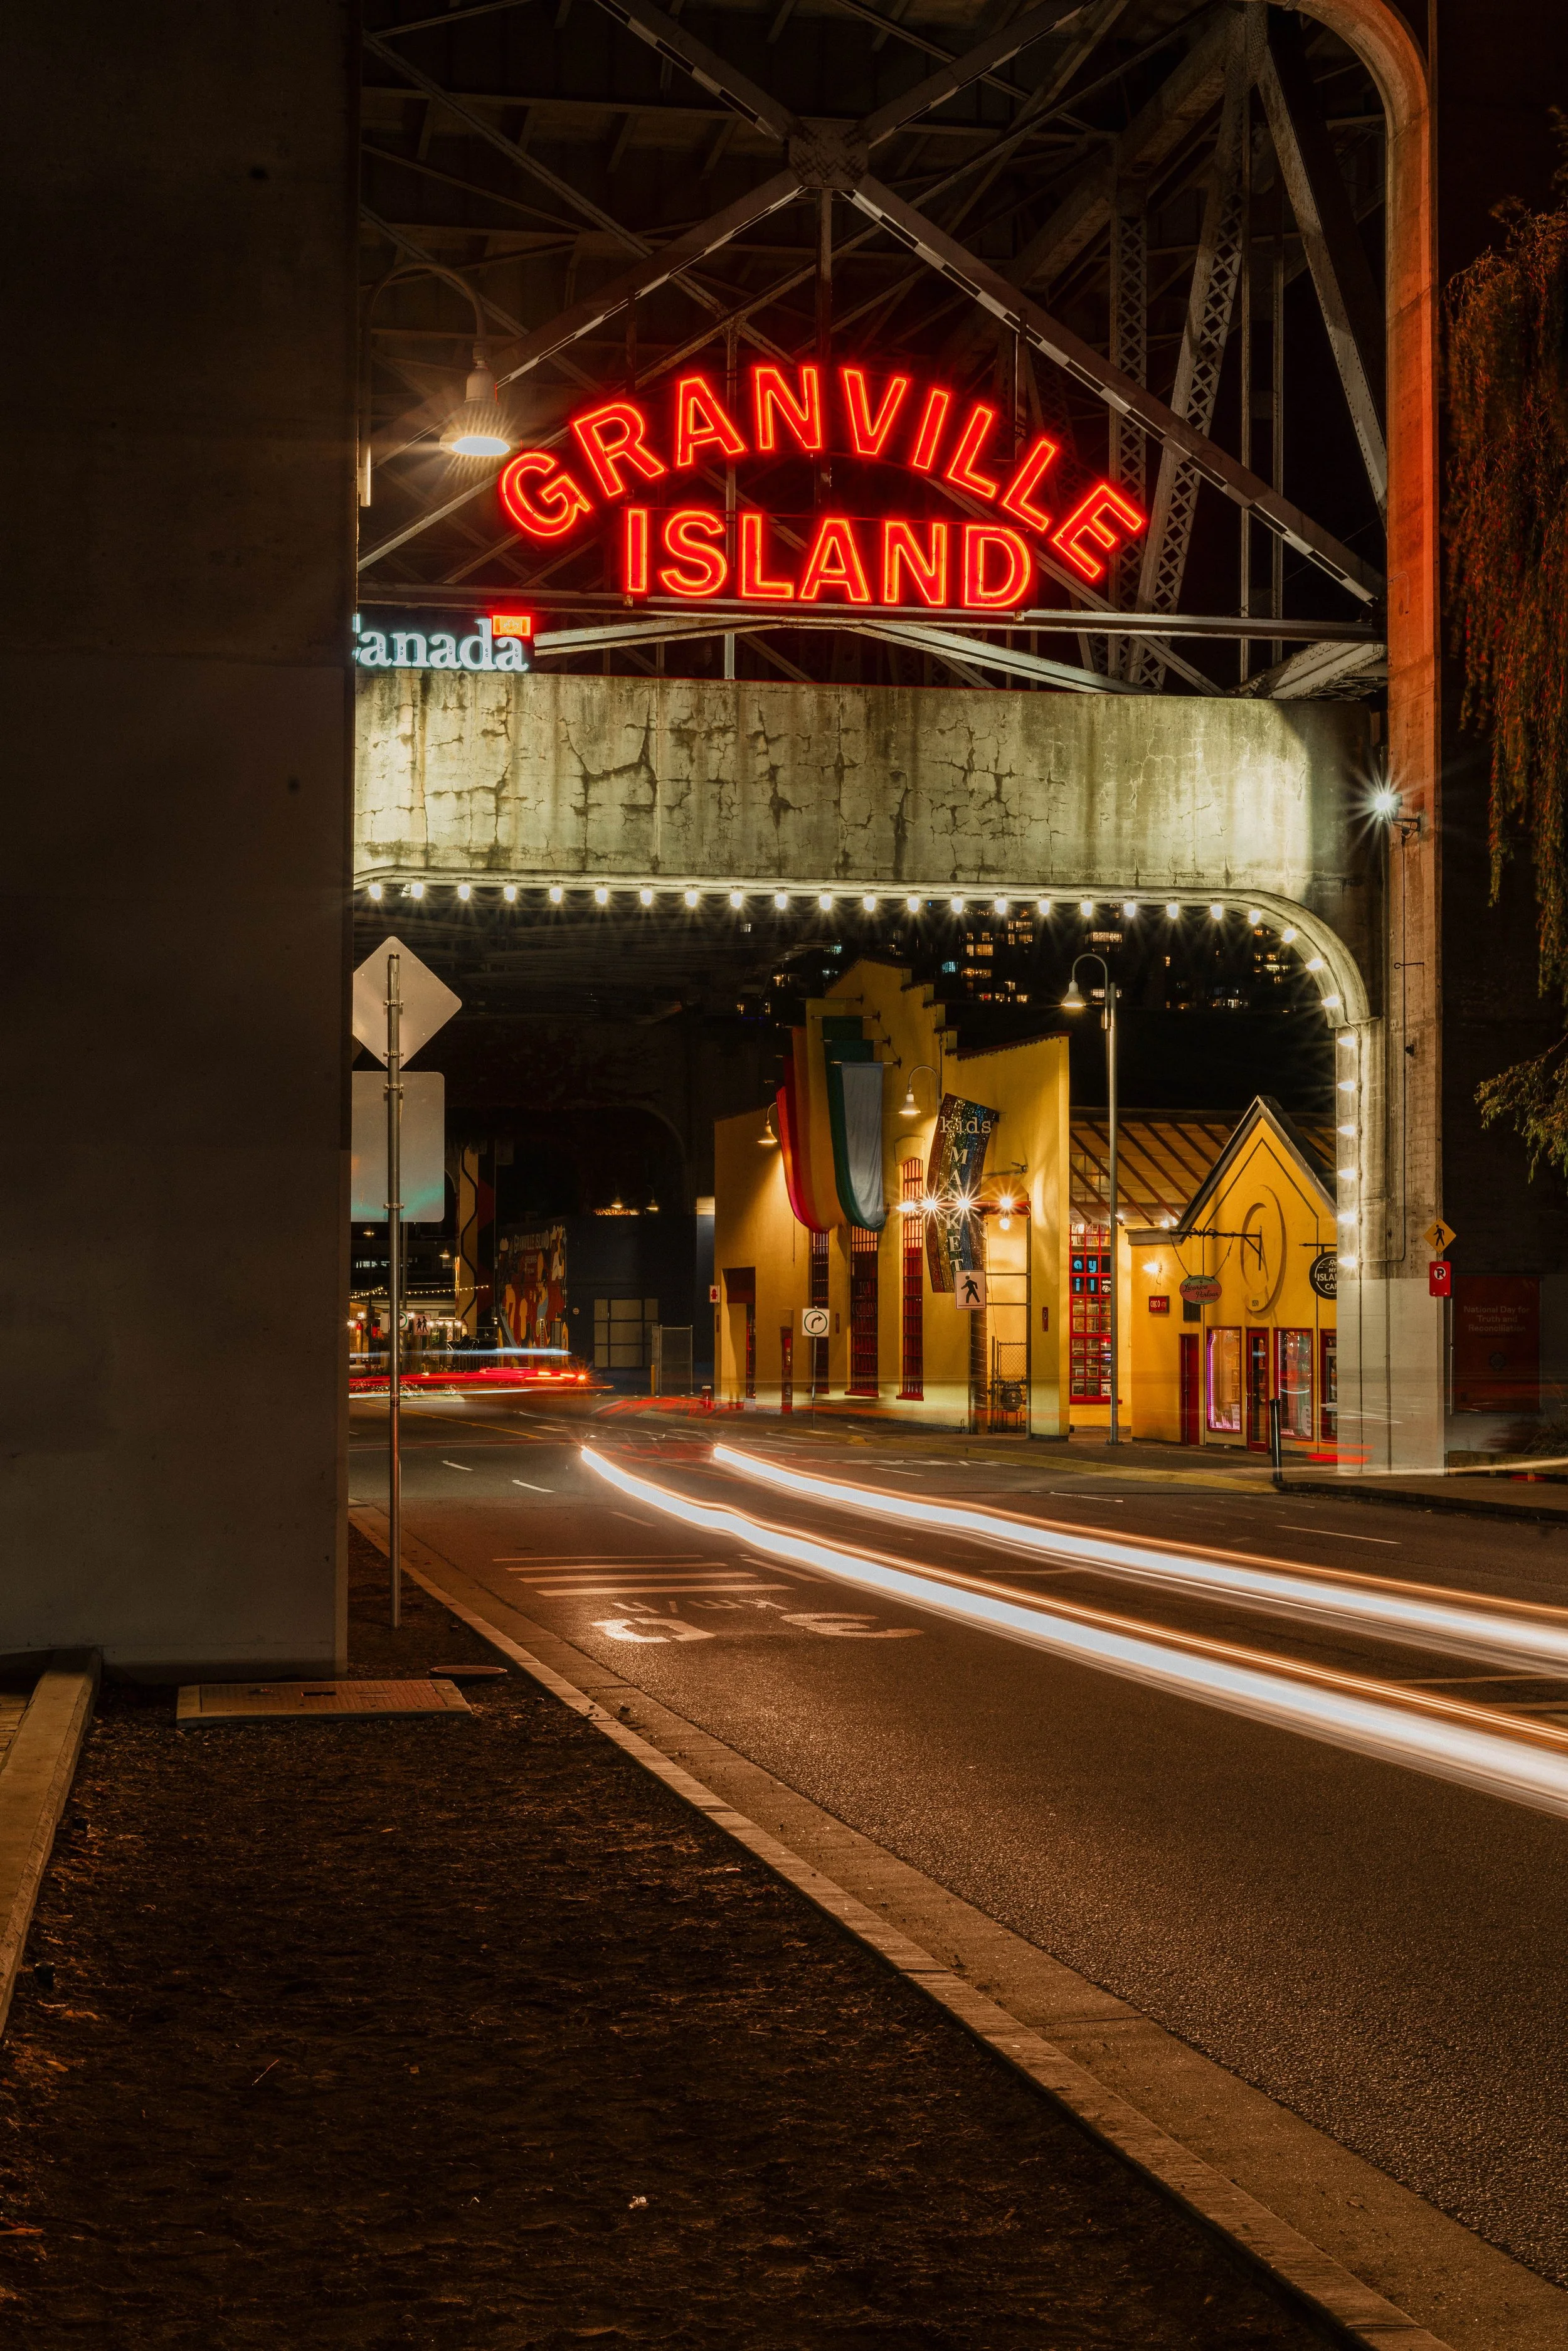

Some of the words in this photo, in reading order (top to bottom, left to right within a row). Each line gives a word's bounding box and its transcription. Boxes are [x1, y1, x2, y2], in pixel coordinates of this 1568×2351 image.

[500, 364, 1147, 580] GRANVILLE
[625, 506, 1034, 608] ISLAND
[352, 613, 529, 671] anada
[940, 1116, 992, 1134] kids
[946, 1146, 970, 1271] MAKET
[1317, 1273, 1337, 1282] ISLA
[1463, 1305, 1498, 1313] National
[1500, 1305, 1517, 1315] Day
[1518, 1305, 1530, 1313] for
[1476, 1315, 1501, 1323] Truth
[1503, 1315, 1518, 1323] and
[1468, 1324, 1526, 1332] Reconciliation
